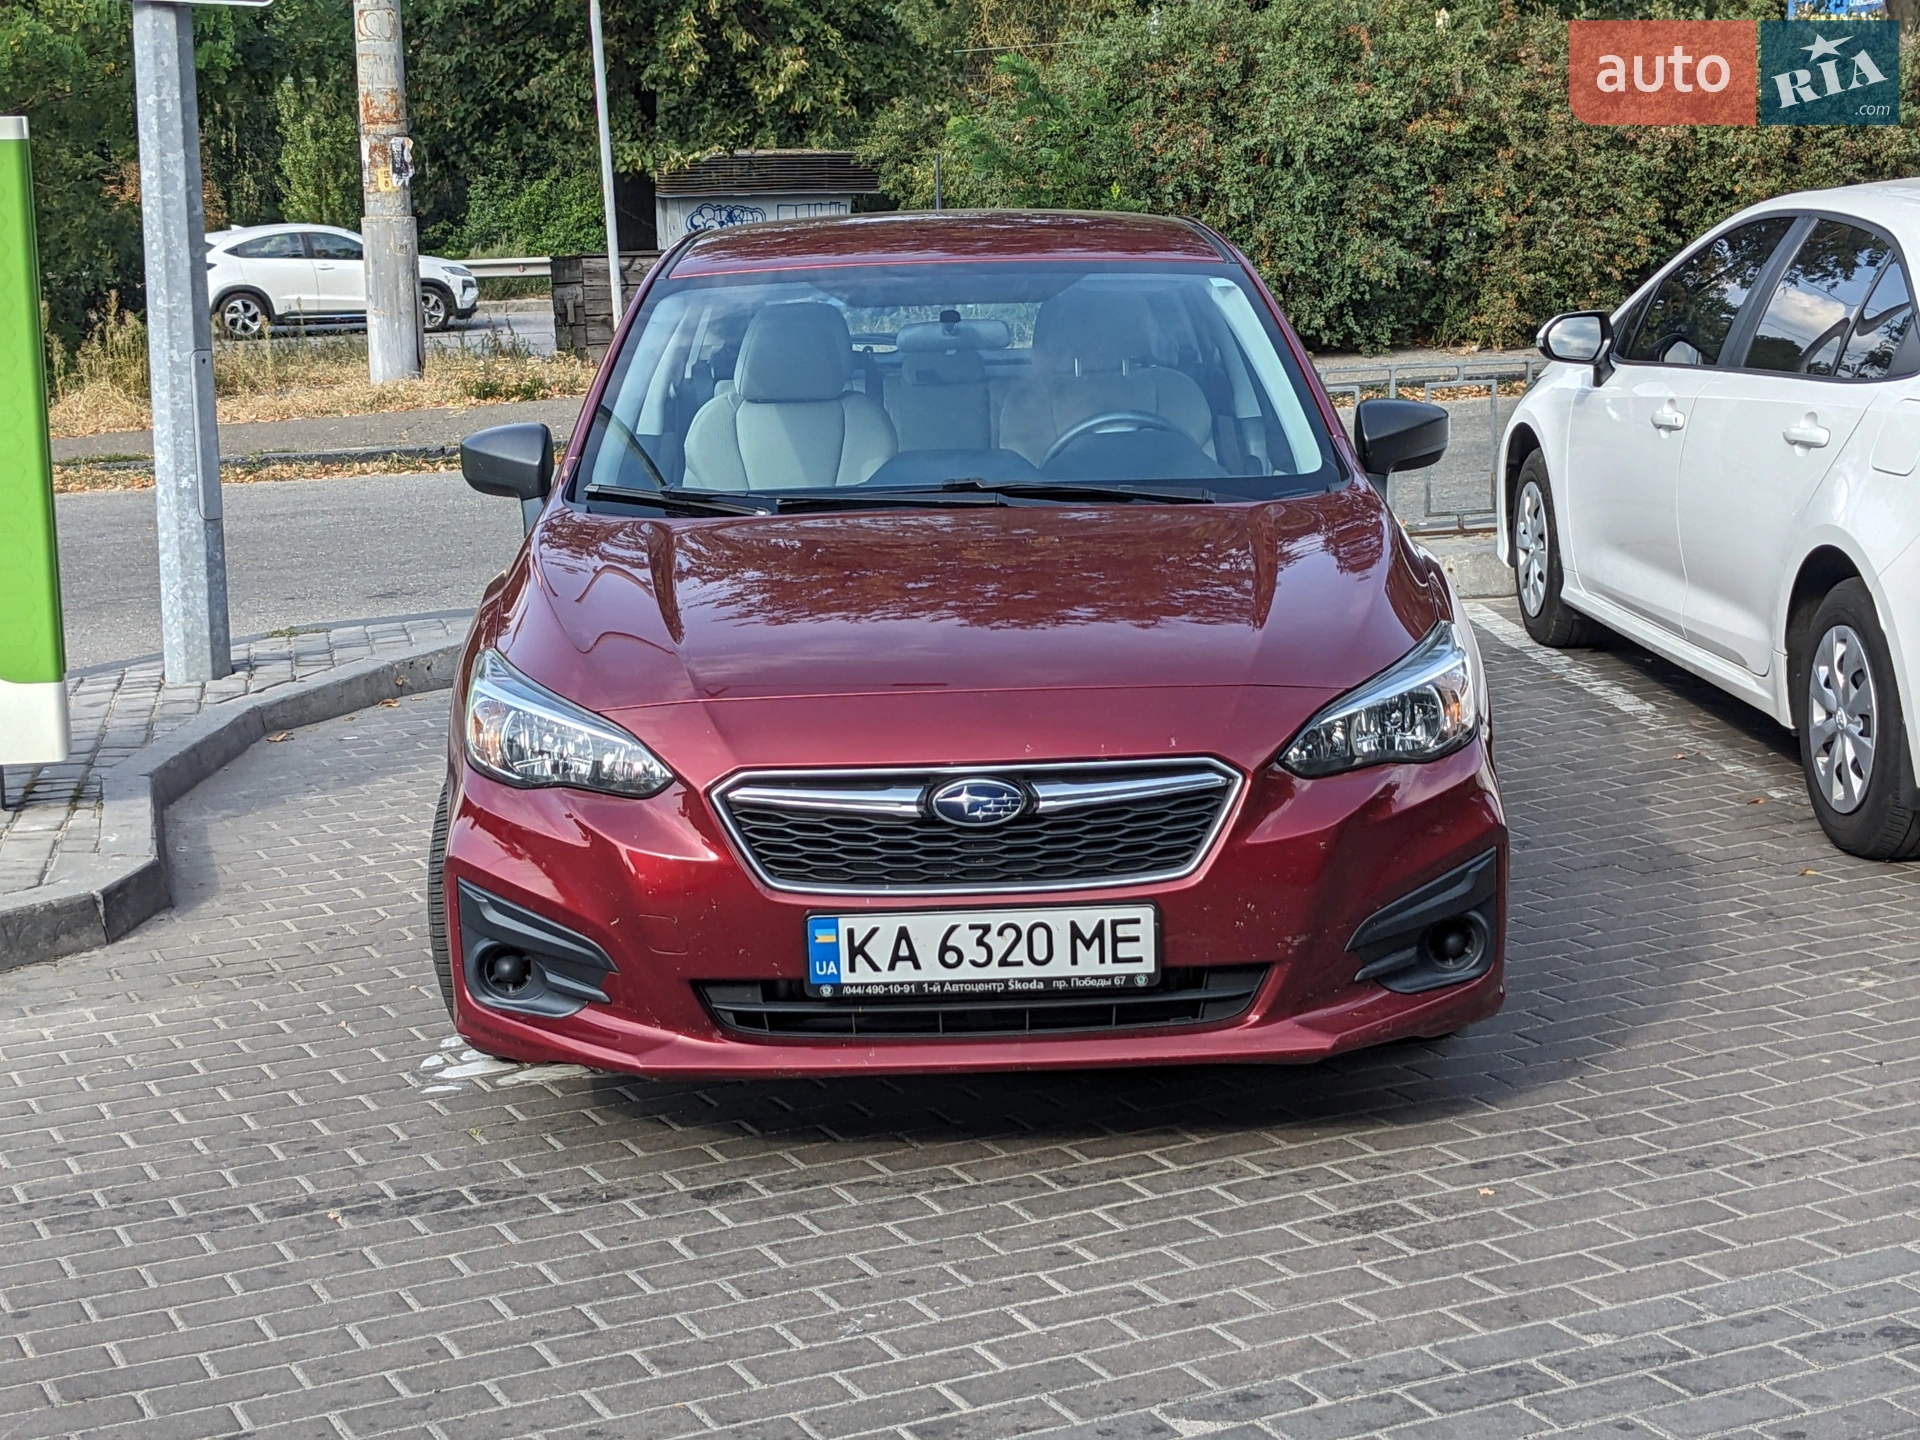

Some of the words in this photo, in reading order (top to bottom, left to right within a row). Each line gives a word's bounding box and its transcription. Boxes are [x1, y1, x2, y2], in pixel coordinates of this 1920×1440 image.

[846, 925, 922, 973] KA
[937, 921, 1054, 970] 6320
[1069, 917, 1144, 966] ME
[815, 961, 838, 975] UA
[922, 982, 941, 993] 1-й
[943, 981, 1005, 994] Автоцентр
[1008, 978, 1045, 990] Škoda
[1052, 980, 1069, 990] пр.
[1070, 976, 1112, 988] Победы
[1113, 976, 1126, 985] 67
